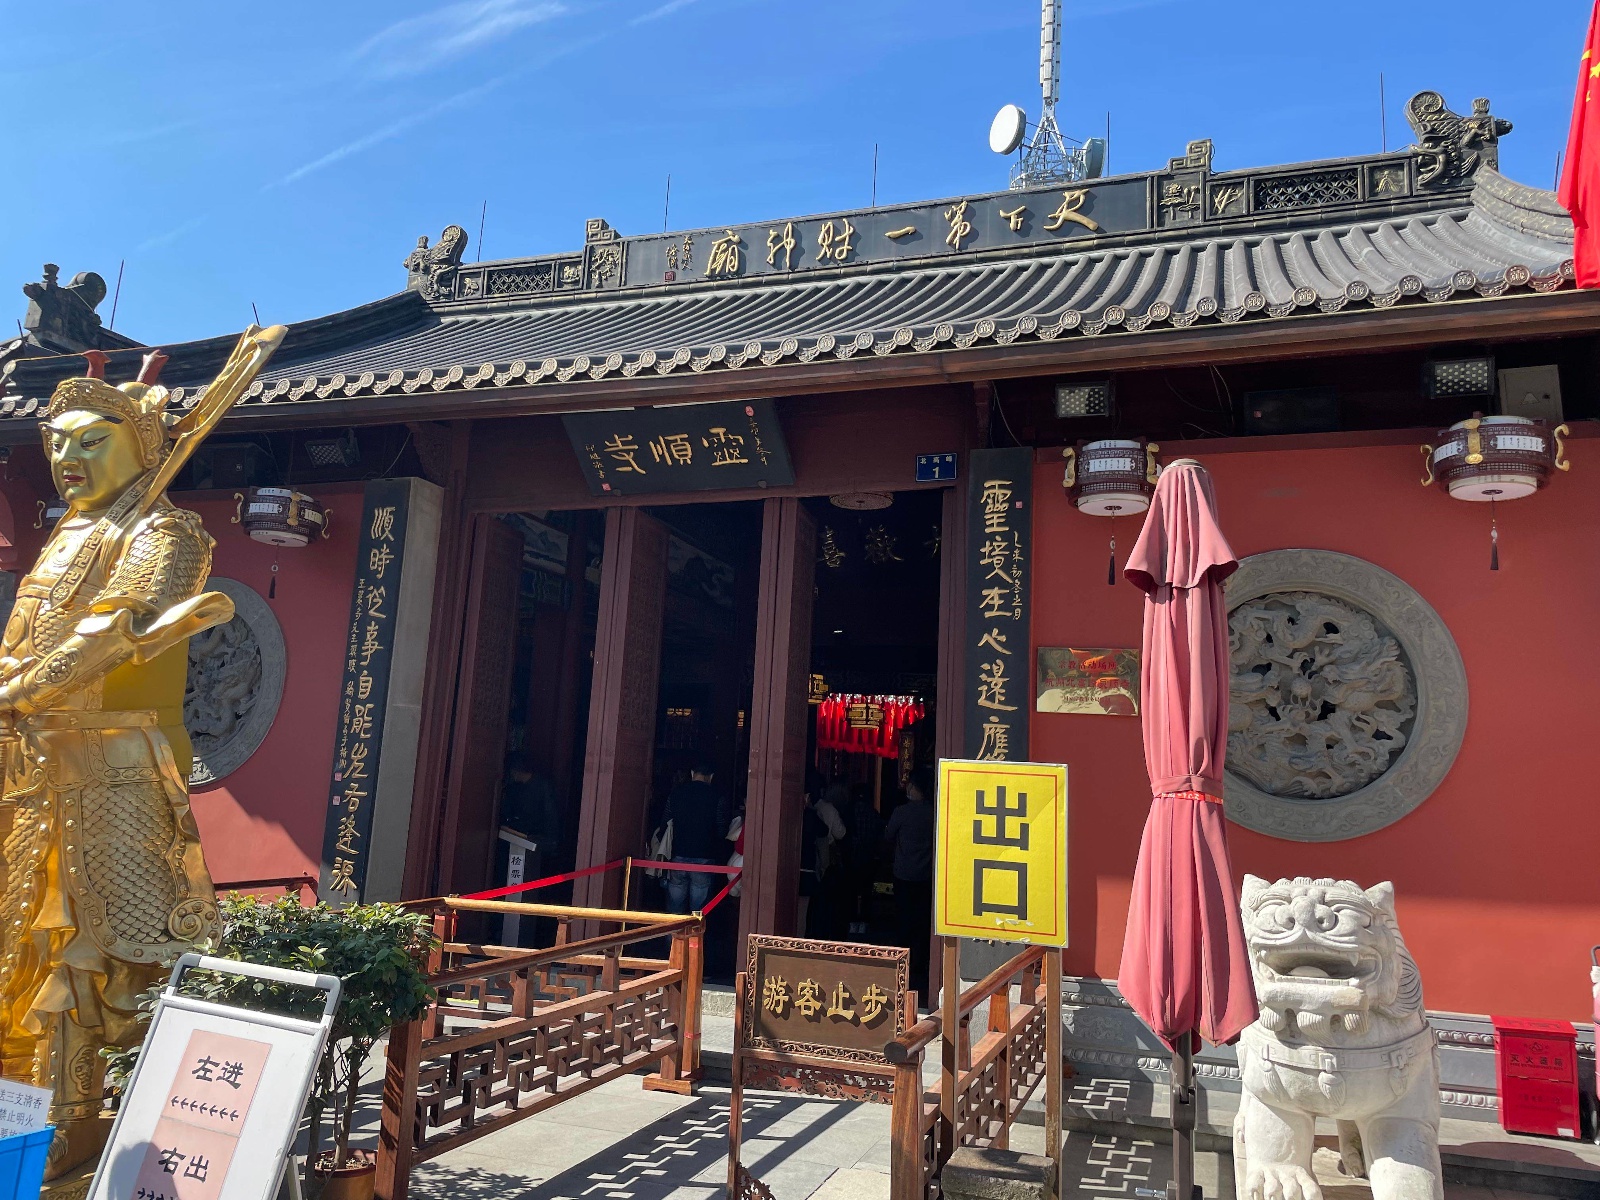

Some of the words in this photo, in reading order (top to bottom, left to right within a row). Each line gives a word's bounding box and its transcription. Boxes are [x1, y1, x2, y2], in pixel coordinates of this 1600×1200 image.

[932, 466, 940, 479] 1
[973, 785, 1030, 920] 出口
[763, 975, 888, 1023] 游客止步
[192, 1055, 244, 1089] 左进
[158, 1146, 211, 1183] 右出
